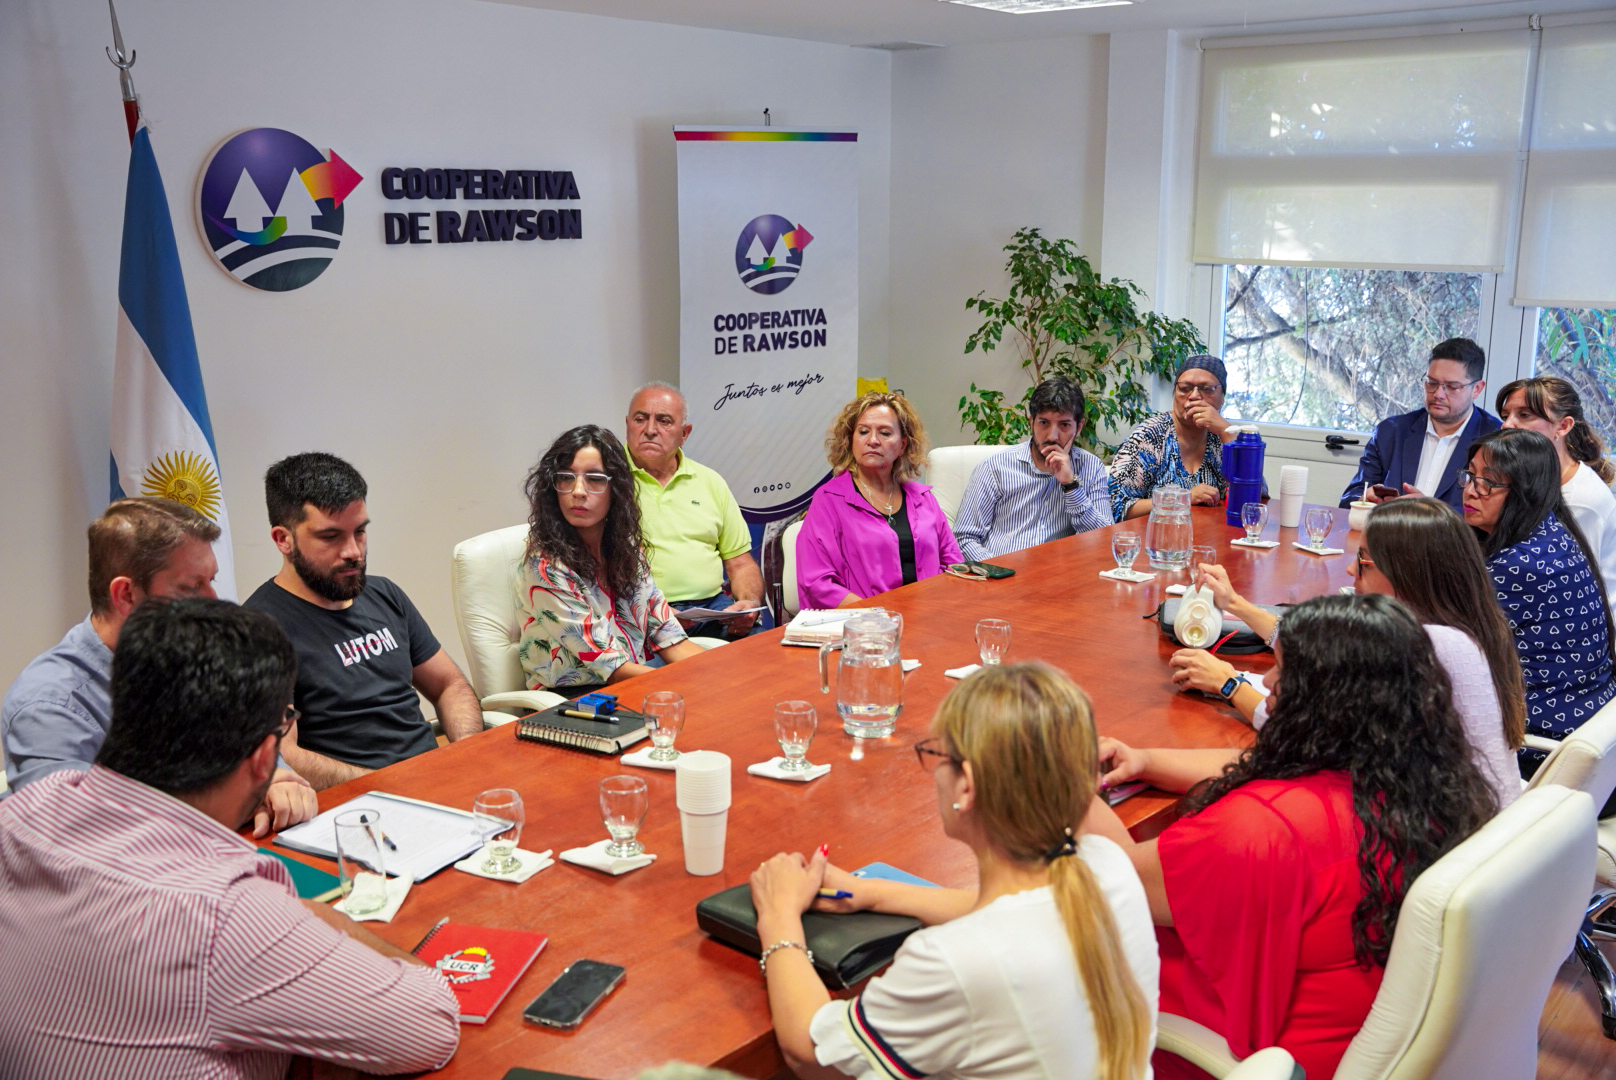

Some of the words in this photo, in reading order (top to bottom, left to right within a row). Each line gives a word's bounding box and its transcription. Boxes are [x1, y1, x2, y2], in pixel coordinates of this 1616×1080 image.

[381, 167, 581, 200] COOPERATIVA
[384, 212, 432, 245] DE
[436, 208, 583, 244] RAWSON
[713, 307, 828, 333] COOPERATIVA
[714, 336, 738, 356] DE
[742, 328, 827, 353] RAWSON
[713, 382, 768, 411] Juntos
[770, 383, 784, 394] es
[786, 373, 825, 396] mejor
[333, 626, 399, 667] LUTOM
[449, 961, 479, 972] UCR
